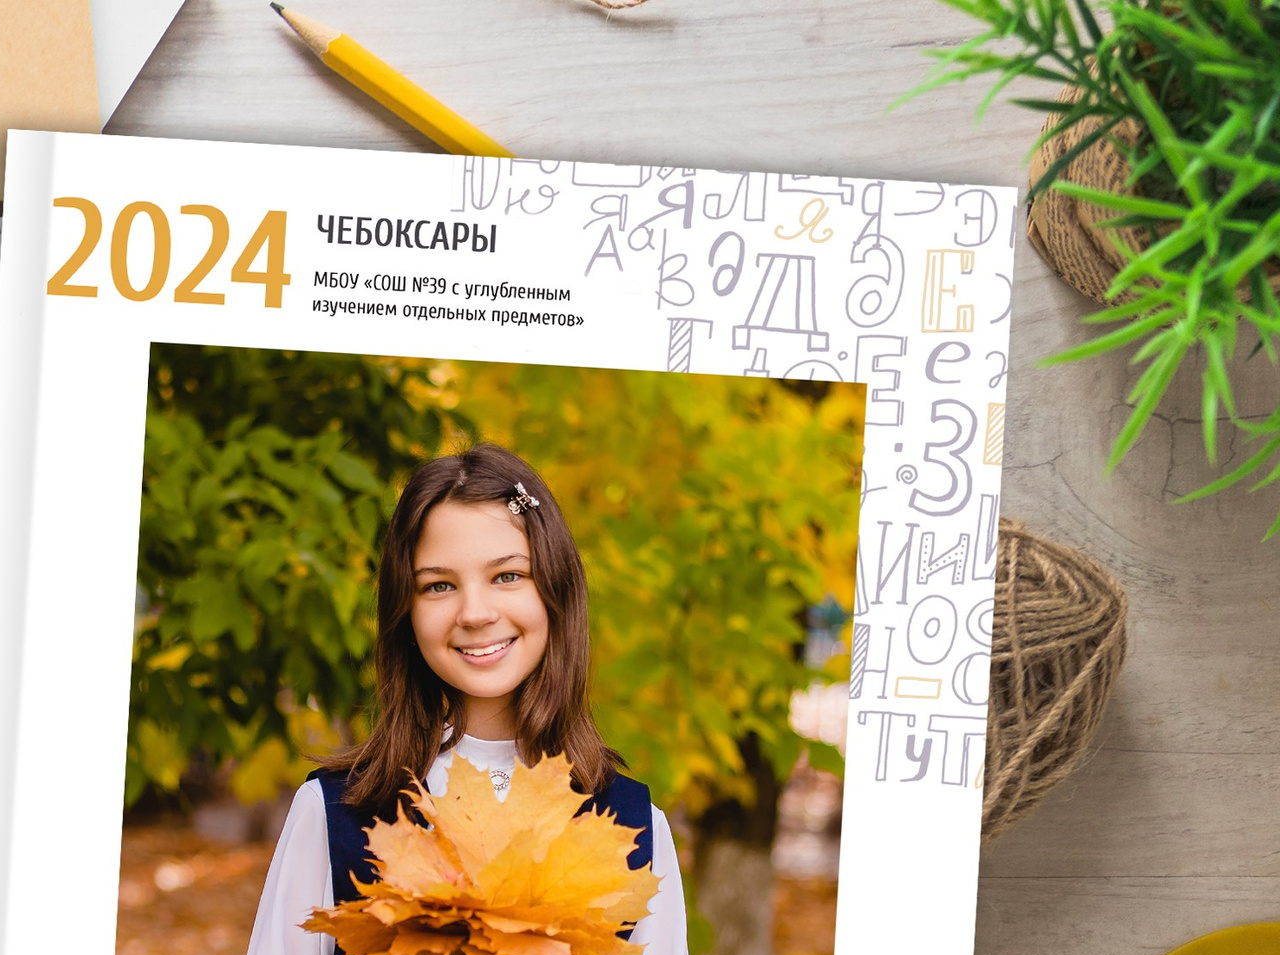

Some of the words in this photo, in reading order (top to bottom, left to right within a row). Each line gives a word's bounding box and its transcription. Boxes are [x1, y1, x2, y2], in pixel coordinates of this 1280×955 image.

[316, 213, 498, 254] ЧЕБОКСАРЫ
[46, 196, 291, 309] 2024
[313, 270, 360, 290] МБОУ
[363, 273, 407, 293] «СОШ
[411, 276, 448, 295] №39
[451, 282, 461, 296] с
[464, 281, 571, 302] углубленным
[312, 299, 397, 318] изучением
[402, 304, 487, 323] отдельных
[491, 309, 585, 328] предметов»
